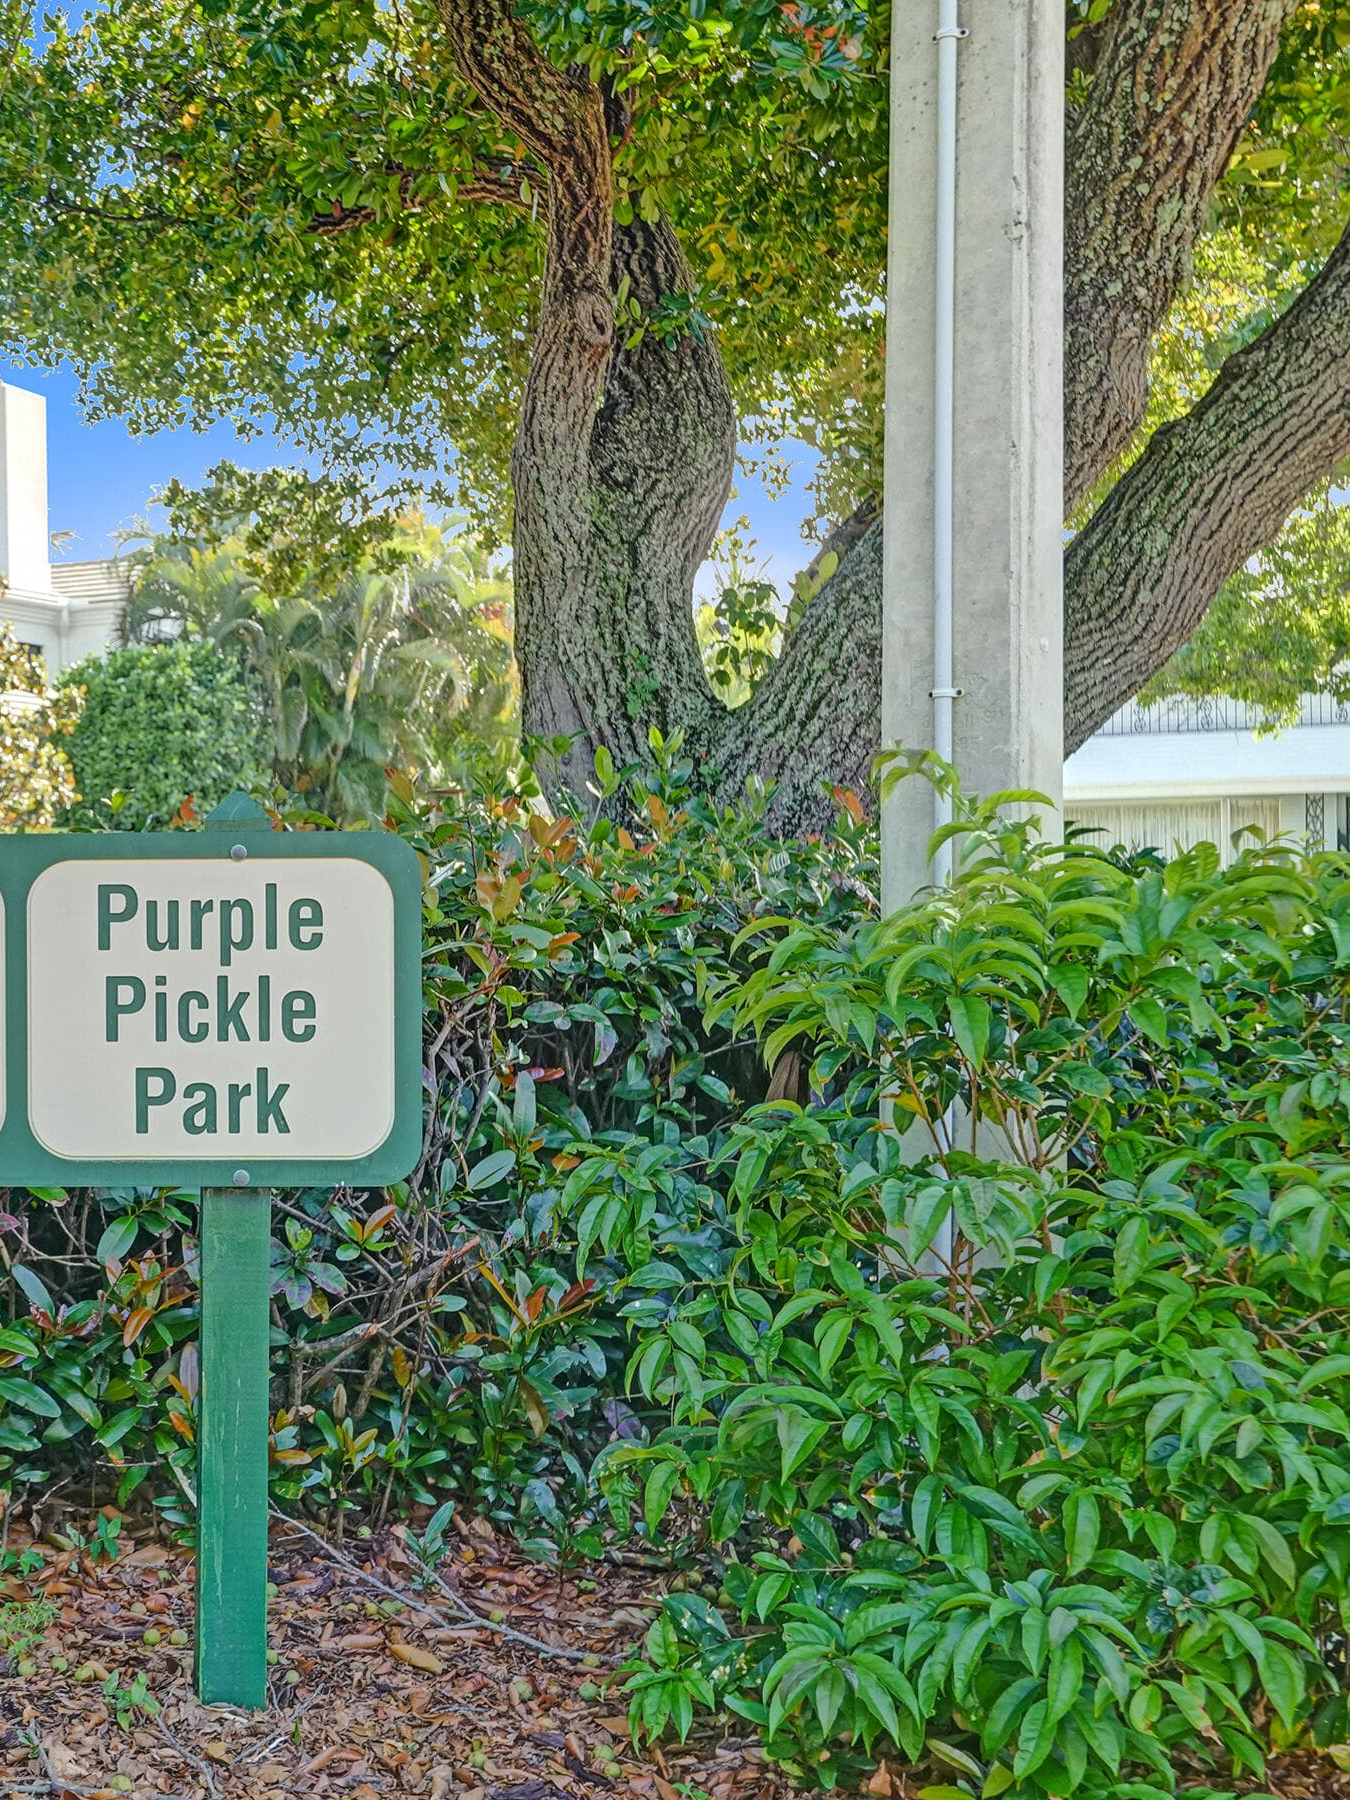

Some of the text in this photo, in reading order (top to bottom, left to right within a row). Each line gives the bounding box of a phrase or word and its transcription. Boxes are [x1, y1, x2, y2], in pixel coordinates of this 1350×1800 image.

[97, 883, 324, 966] Purple
[105, 975, 316, 1043] Pickle
[135, 1067, 290, 1135] Park
